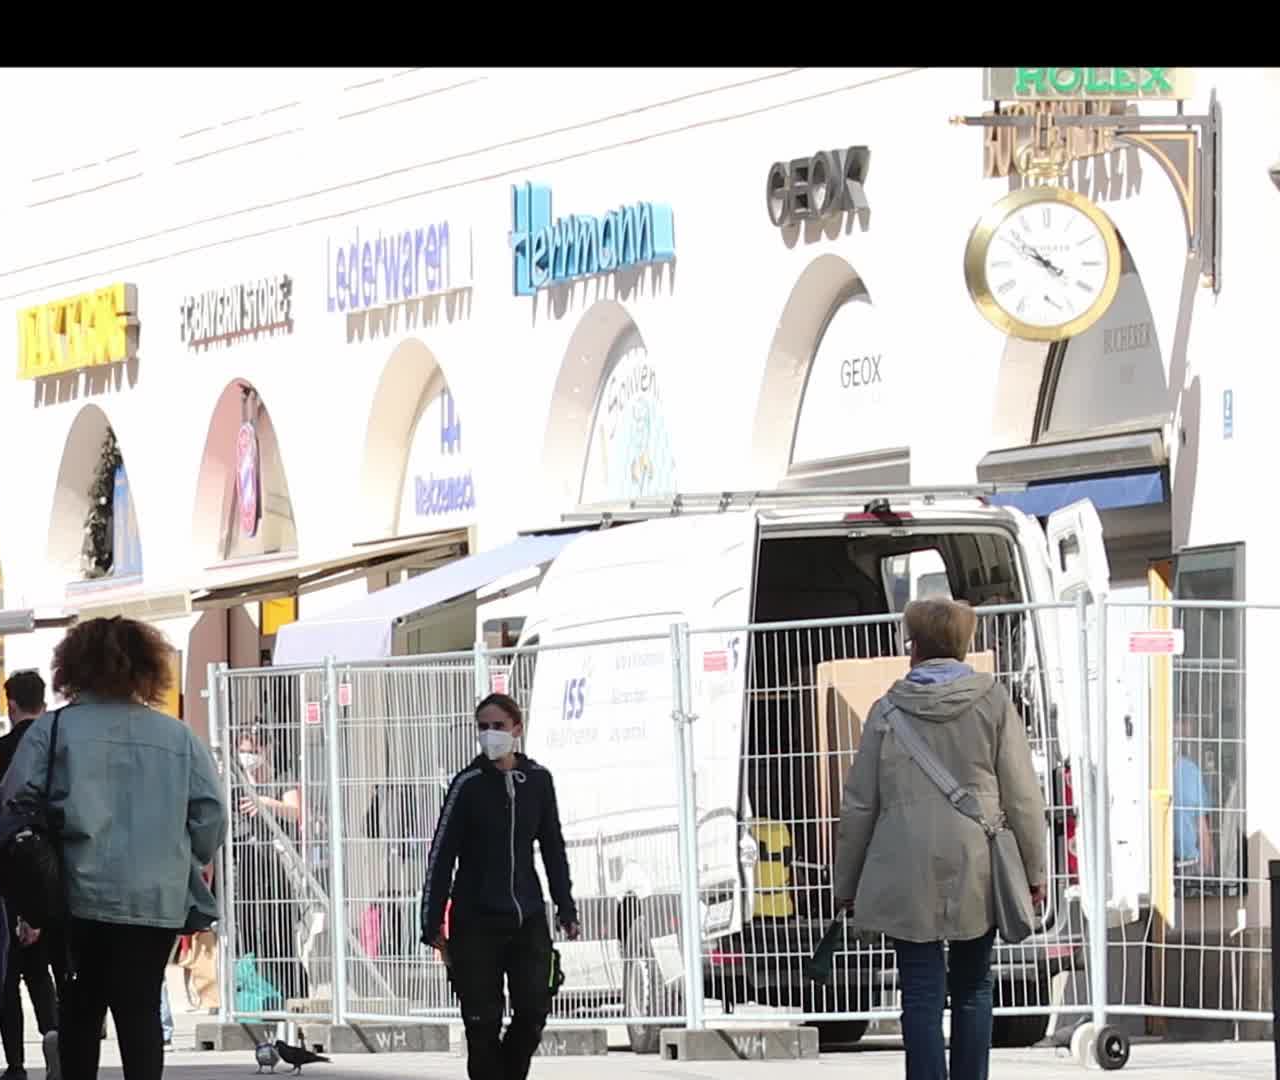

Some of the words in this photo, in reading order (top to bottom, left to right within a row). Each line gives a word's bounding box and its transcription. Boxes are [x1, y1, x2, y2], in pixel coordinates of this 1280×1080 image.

[1013, 67, 1173, 93] ROLEX
[766, 145, 871, 227] GEOX
[507, 179, 675, 297] Herrmann
[325, 220, 450, 313] Lederwaren
[194, 283, 244, 341] BAYERN
[243, 274, 292, 332] STORE
[840, 353, 882, 389] GEOX
[561, 676, 587, 721] ISS
[375, 1031, 407, 1049] WH
[733, 1035, 767, 1055] WH
